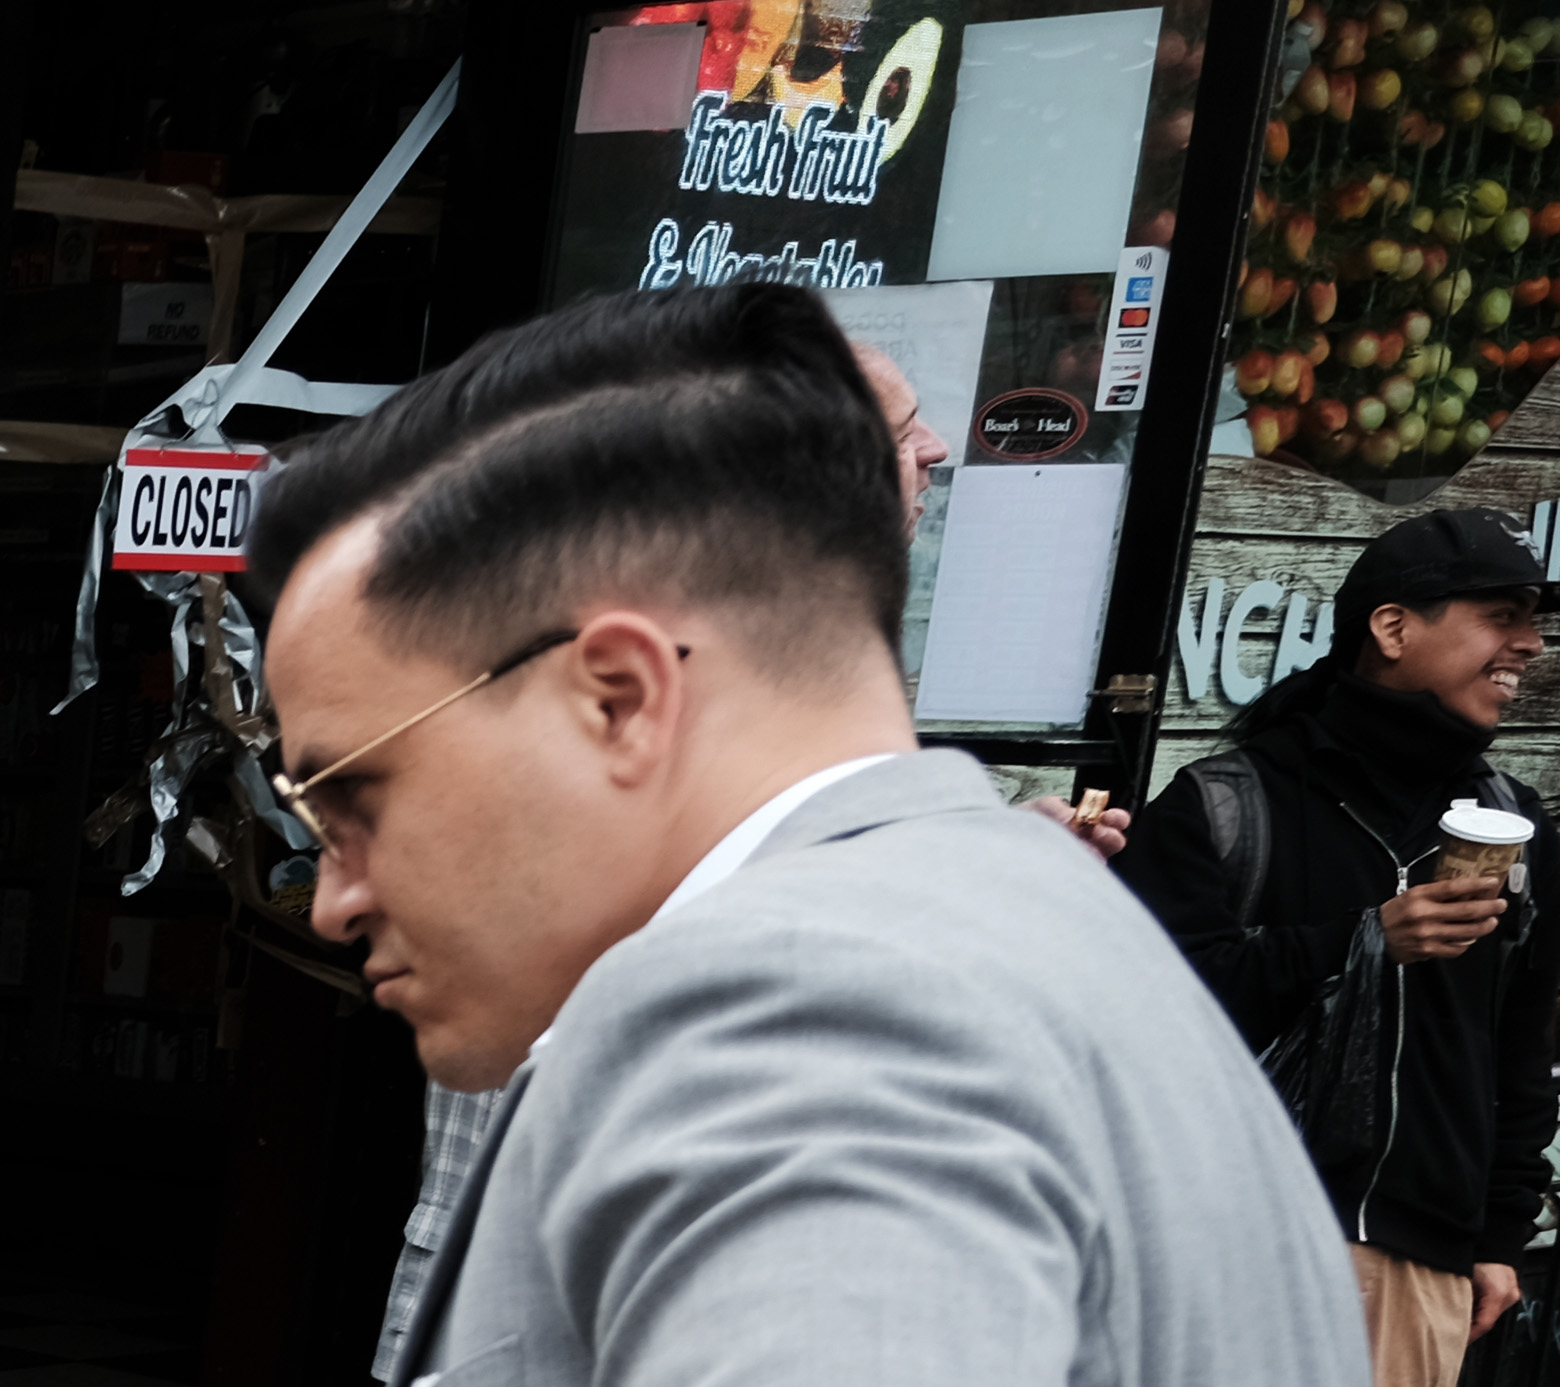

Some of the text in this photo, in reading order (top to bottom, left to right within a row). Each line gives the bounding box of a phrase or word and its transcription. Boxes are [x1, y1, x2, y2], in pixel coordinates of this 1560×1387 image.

[678, 90, 890, 205] Fresh Fruit
[1120, 339, 1143, 348] VISA
[1038, 417, 1070, 432] Head
[131, 474, 252, 549] CLOSED
